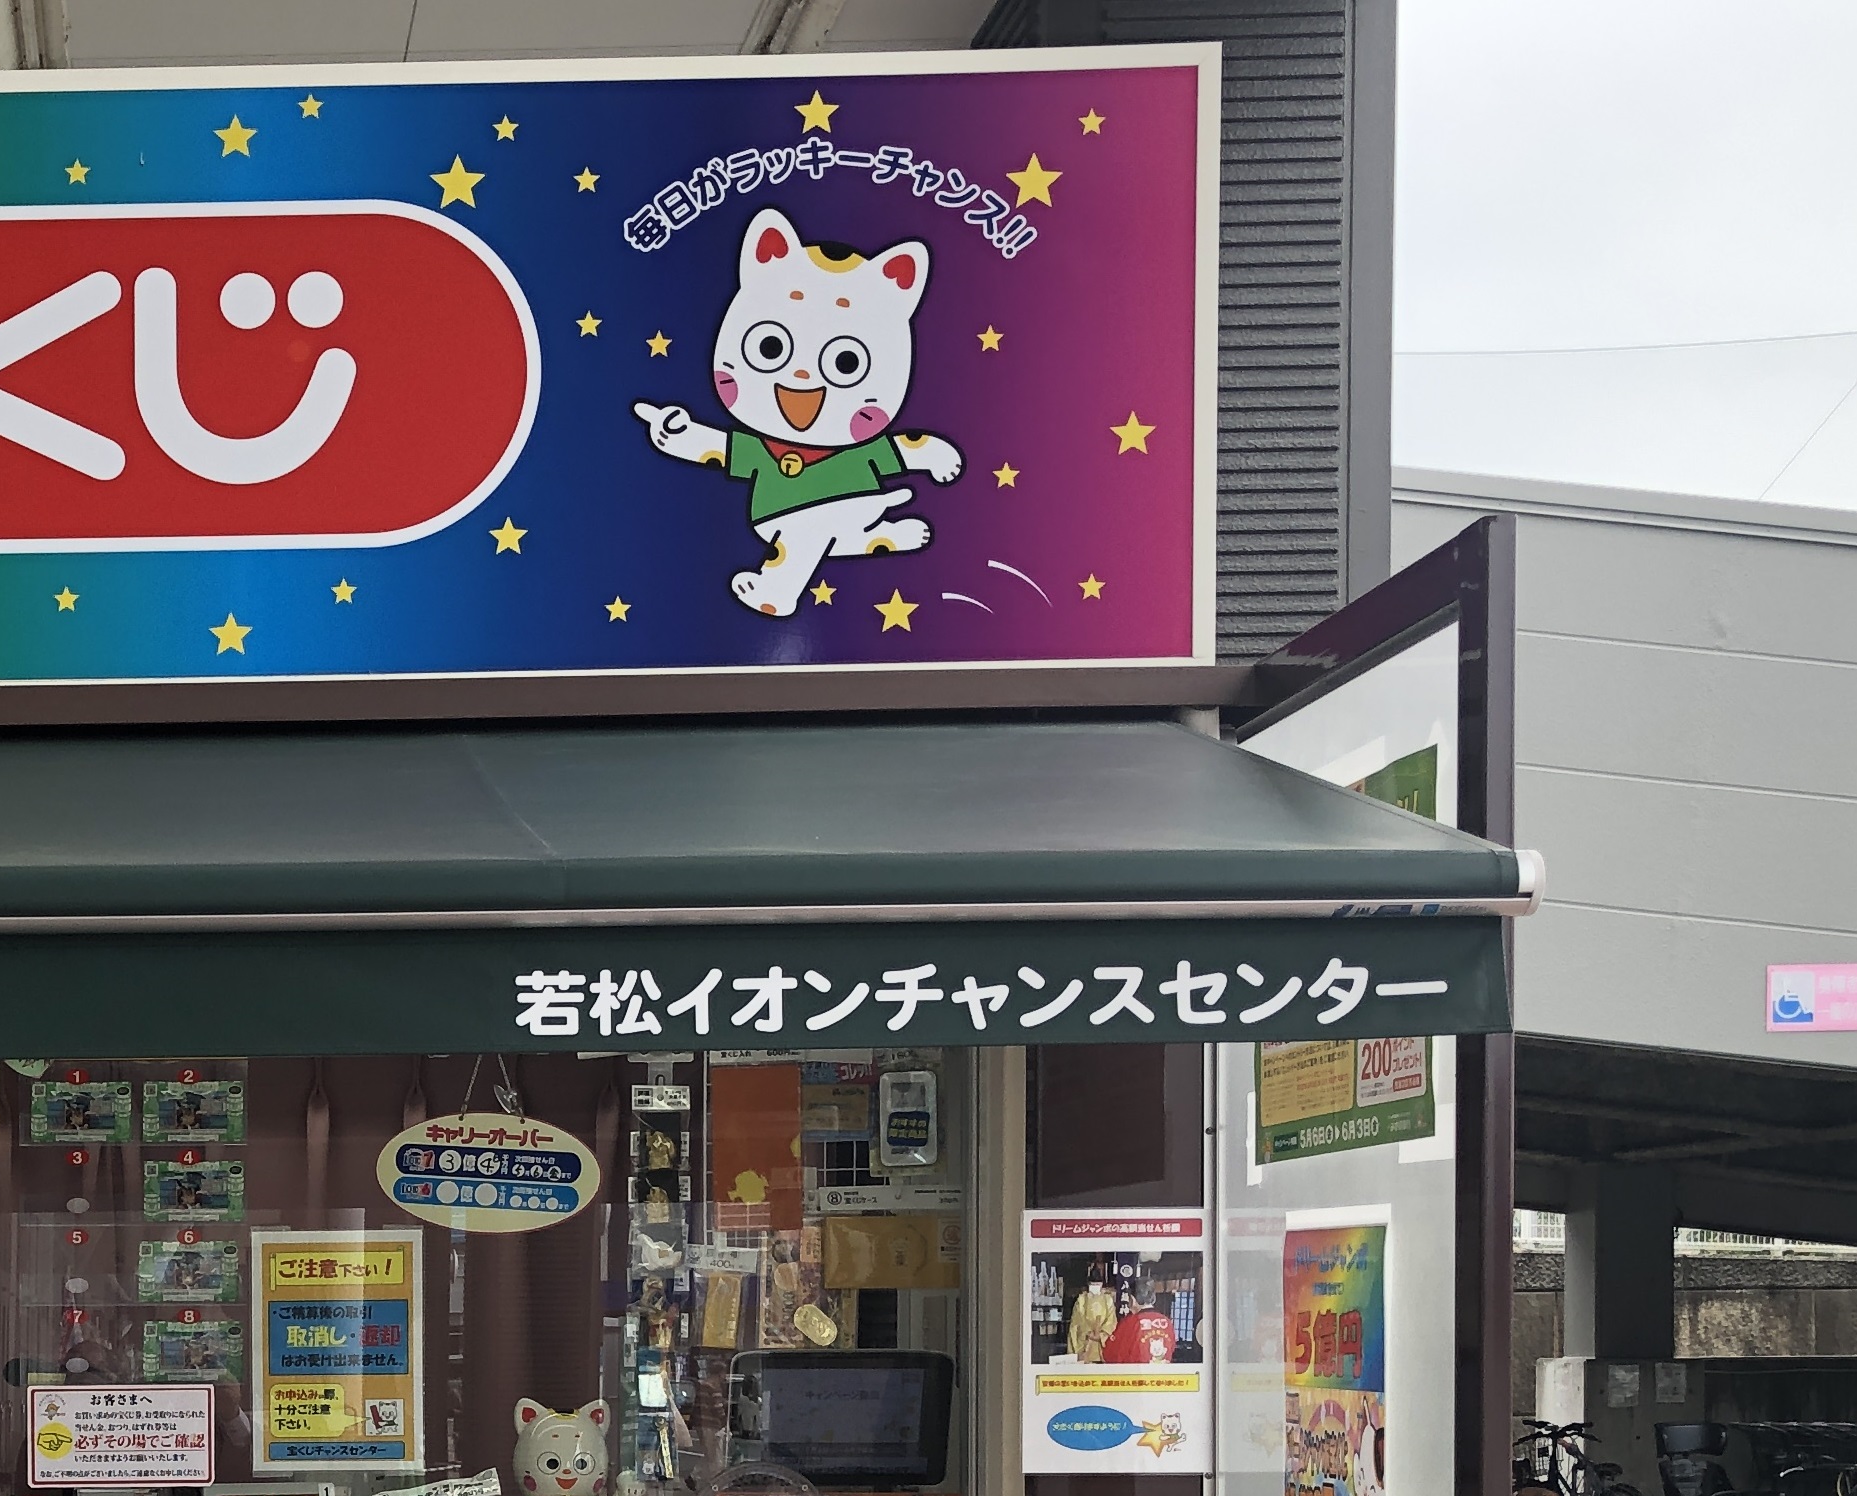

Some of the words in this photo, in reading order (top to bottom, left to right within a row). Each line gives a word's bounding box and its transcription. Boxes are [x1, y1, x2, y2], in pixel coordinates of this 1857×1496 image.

[624, 138, 1037, 259] 毎日がラッキーチャンス!!
[516, 957, 1447, 1037] 若松イオンチャンスセンター
[1362, 1039, 1391, 1080] 200
[72, 1071, 81, 1083] 1
[183, 1070, 194, 1083] 2
[426, 1124, 553, 1147] キャリーオーバー
[72, 1152, 83, 1164] 3
[183, 1151, 194, 1163] 4
[72, 1232, 82, 1244] 5
[183, 1231, 194, 1243] 6
[278, 1258, 392, 1279] ご注意下さい!
[73, 1311, 82, 1322] 7
[183, 1310, 195, 1322] 8
[1295, 1309, 1362, 1379] 5億円
[282, 1354, 405, 1367] はお受け出来ません。
[90, 1394, 153, 1406] お客さまへ
[274, 1403, 331, 1416] 十分ご注意
[274, 1418, 311, 1431] 下さい。
[74, 1433, 205, 1449] 必ずその場でご確認
[286, 1445, 387, 1457] 宝くじチャンスセンター
[75, 1454, 188, 1462] いただきますようお願いいたします。
[324, 1487, 329, 1496] 1
